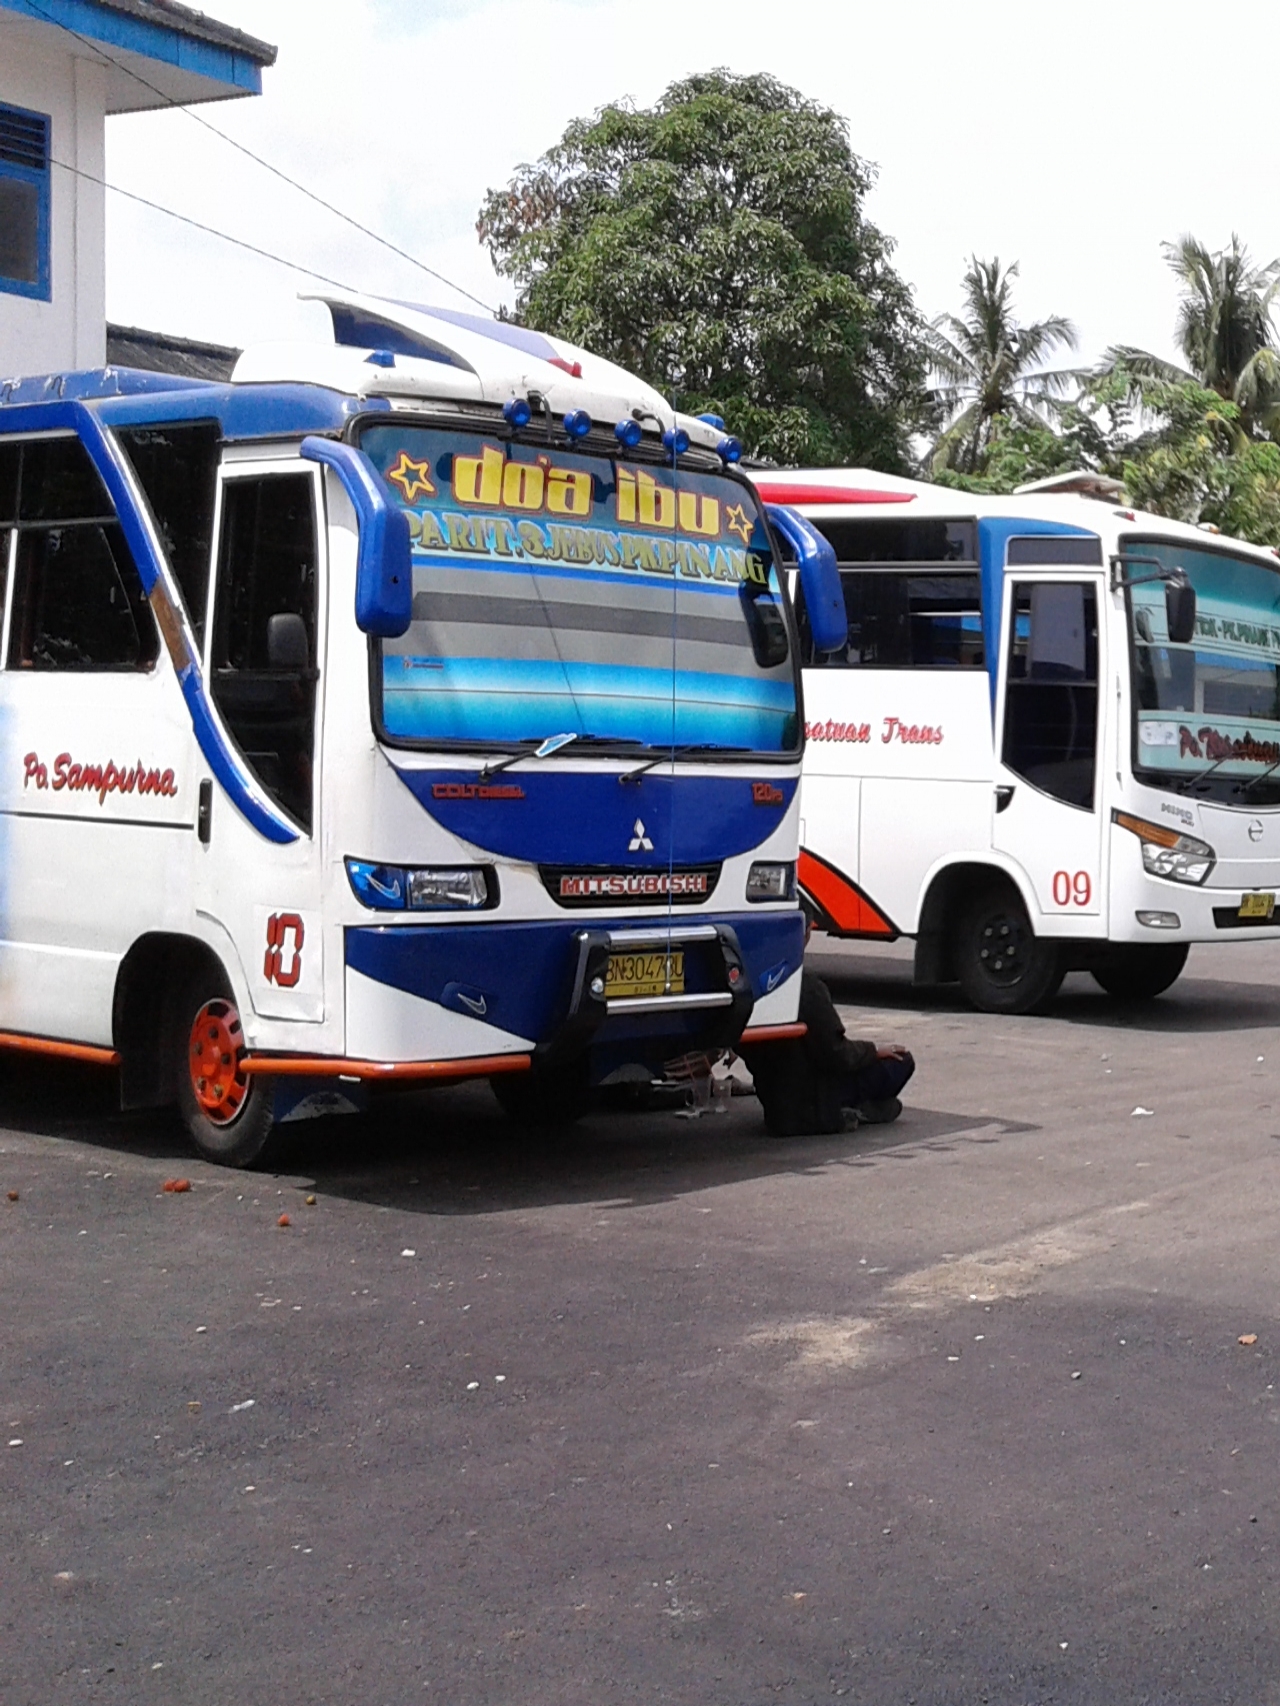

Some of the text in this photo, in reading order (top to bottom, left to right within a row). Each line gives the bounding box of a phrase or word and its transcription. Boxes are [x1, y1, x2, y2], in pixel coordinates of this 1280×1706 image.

[616, 465, 721, 537] ibu
[881, 717, 944, 745] Trans
[52, 752, 178, 806] Sampurna
[560, 873, 709, 896] MITSUBISHI
[1053, 870, 1091, 906] 09
[264, 912, 304, 988] 10
